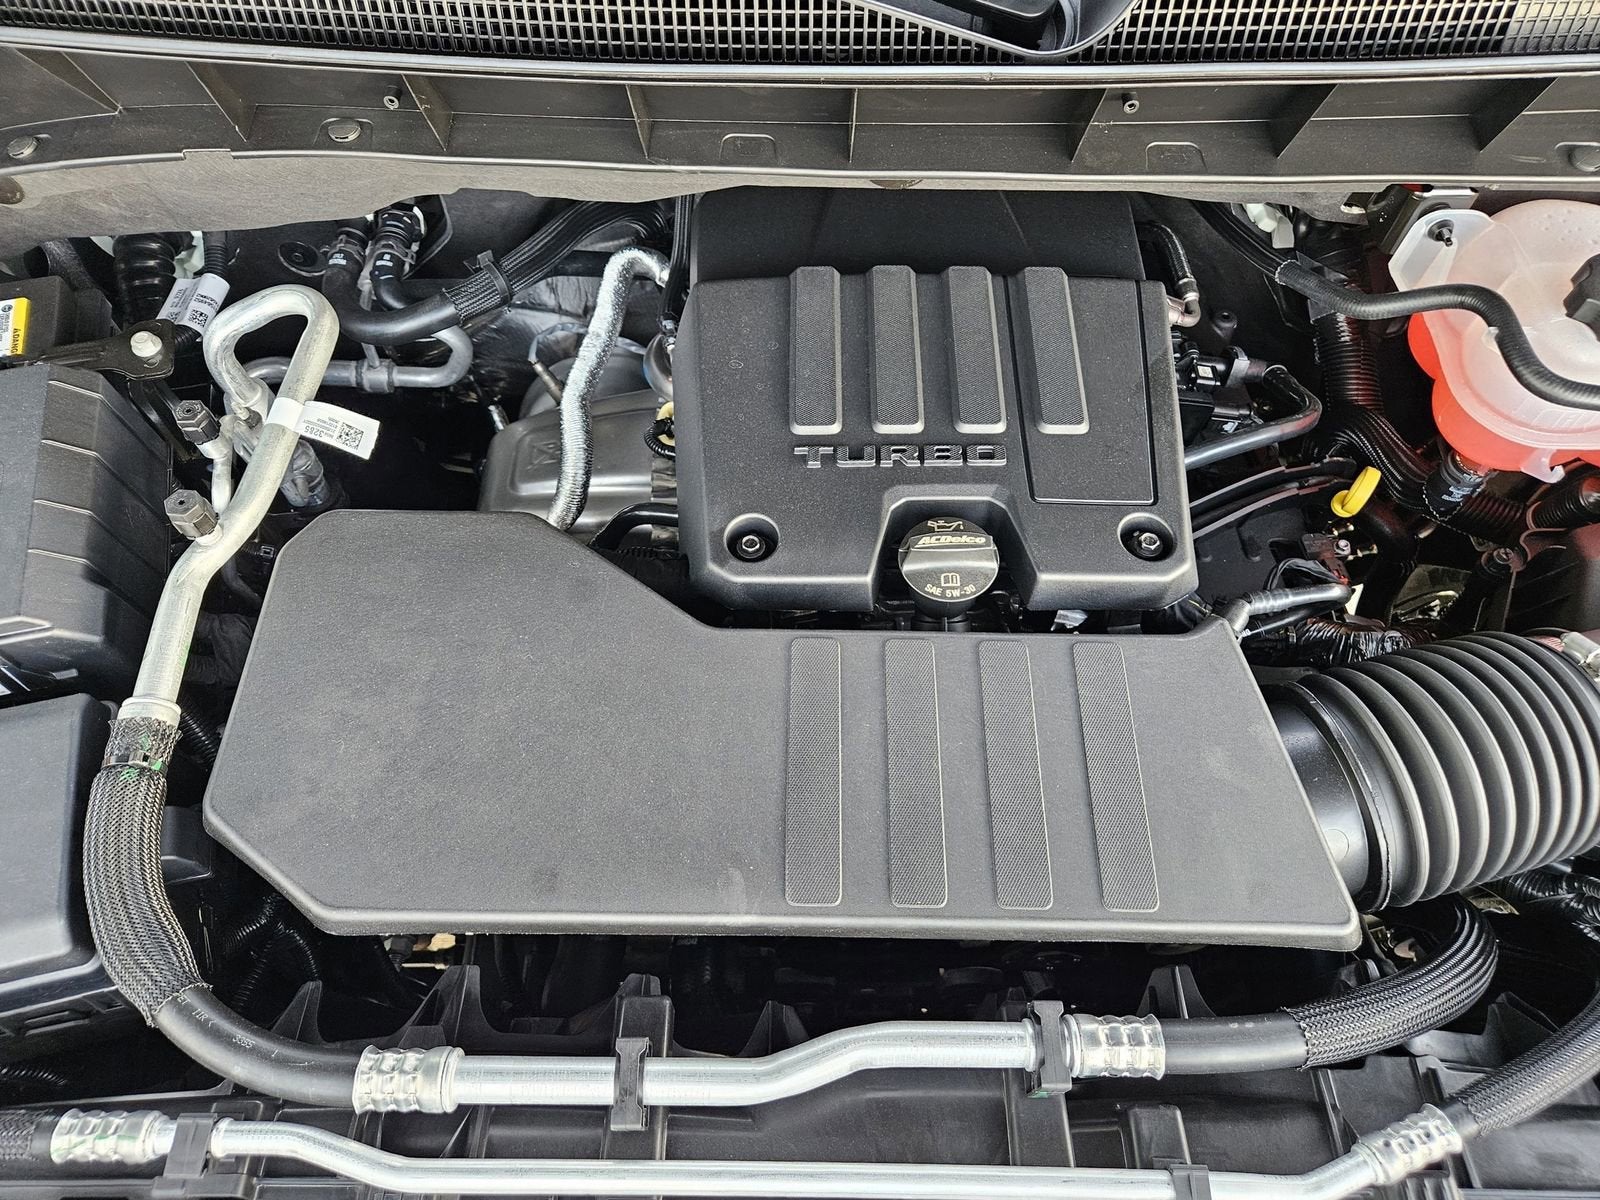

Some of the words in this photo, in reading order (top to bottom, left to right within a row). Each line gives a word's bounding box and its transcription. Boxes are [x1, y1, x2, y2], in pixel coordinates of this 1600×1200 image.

[794, 444, 1008, 469] TURBO
[915, 534, 987, 547] ACDelco
[924, 583, 943, 597] SAE
[945, 583, 977, 598] 5W-30
